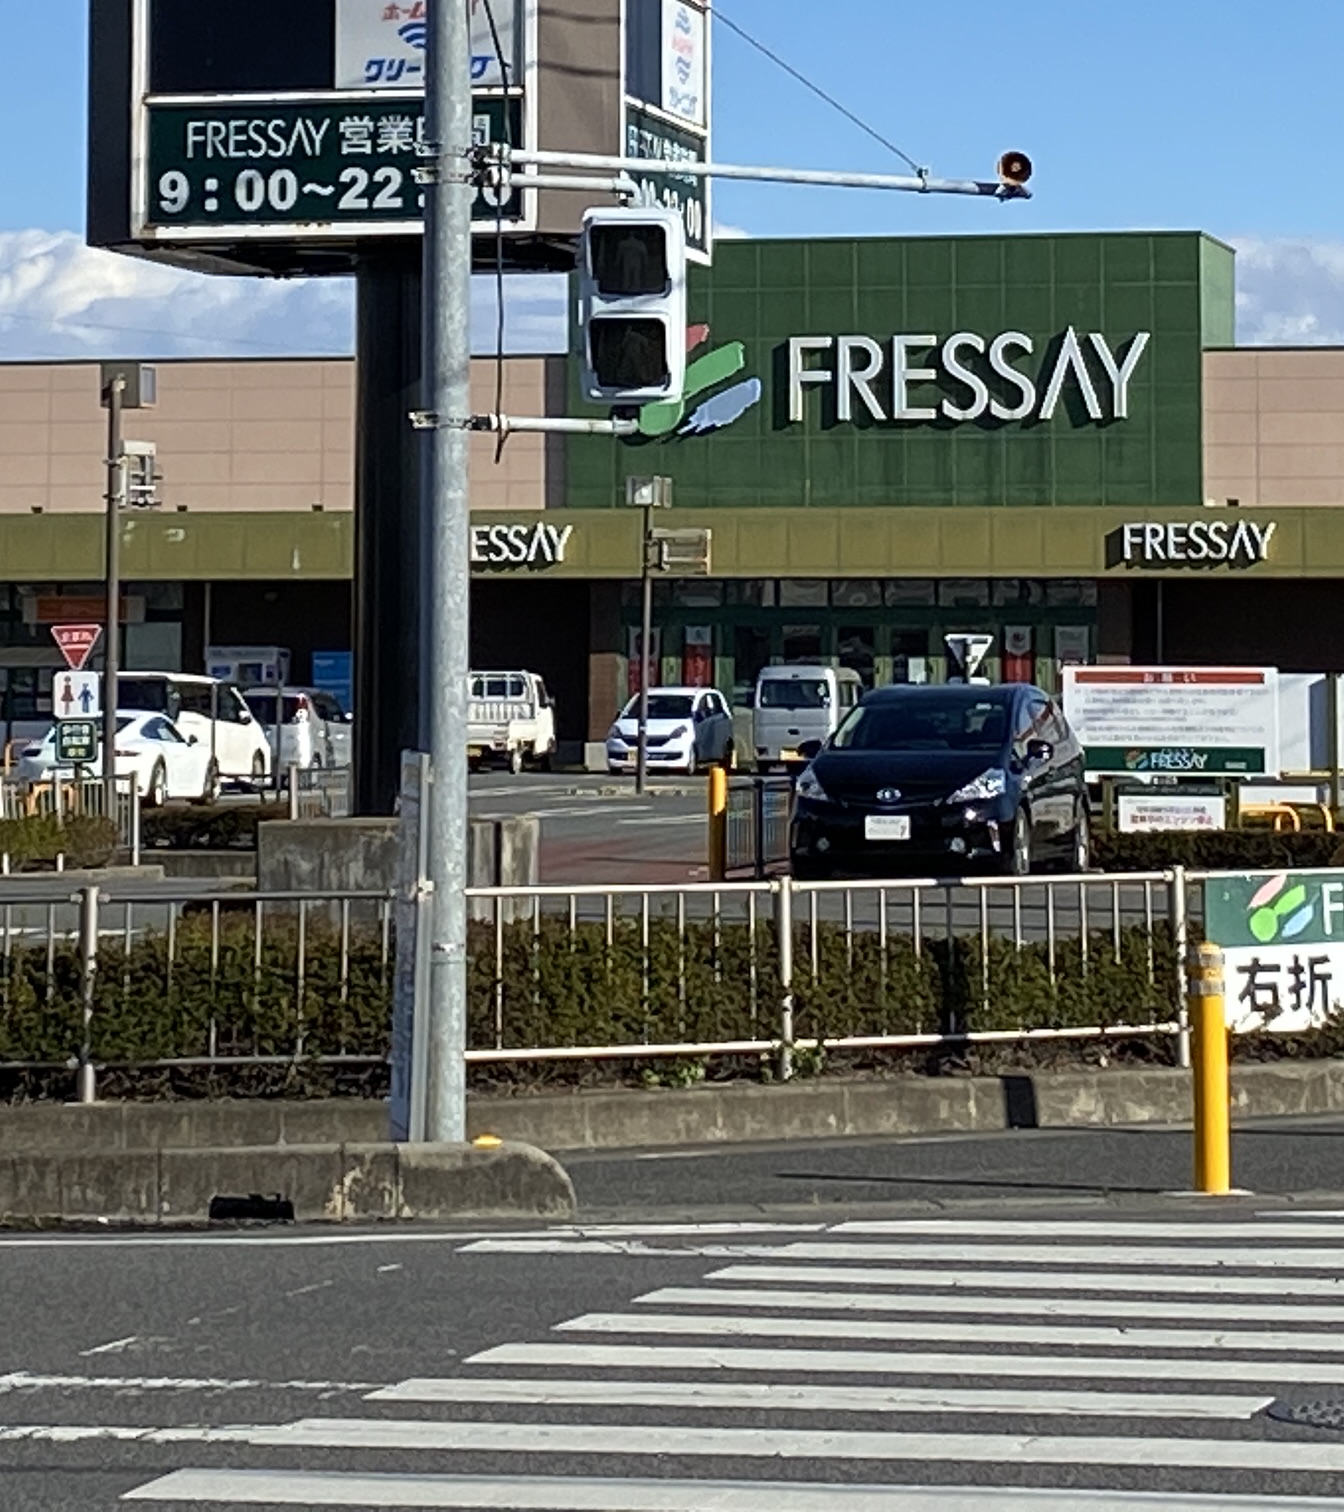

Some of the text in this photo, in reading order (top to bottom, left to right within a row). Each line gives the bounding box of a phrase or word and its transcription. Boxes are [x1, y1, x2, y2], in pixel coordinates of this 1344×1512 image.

[186, 114, 490, 159] FRESSAY 営業
[788, 325, 1150, 421] FRESSAY
[469, 521, 574, 562] ESSAY
[1122, 519, 1277, 562] FRESSAY
[1236, 954, 1333, 1013] 右折
